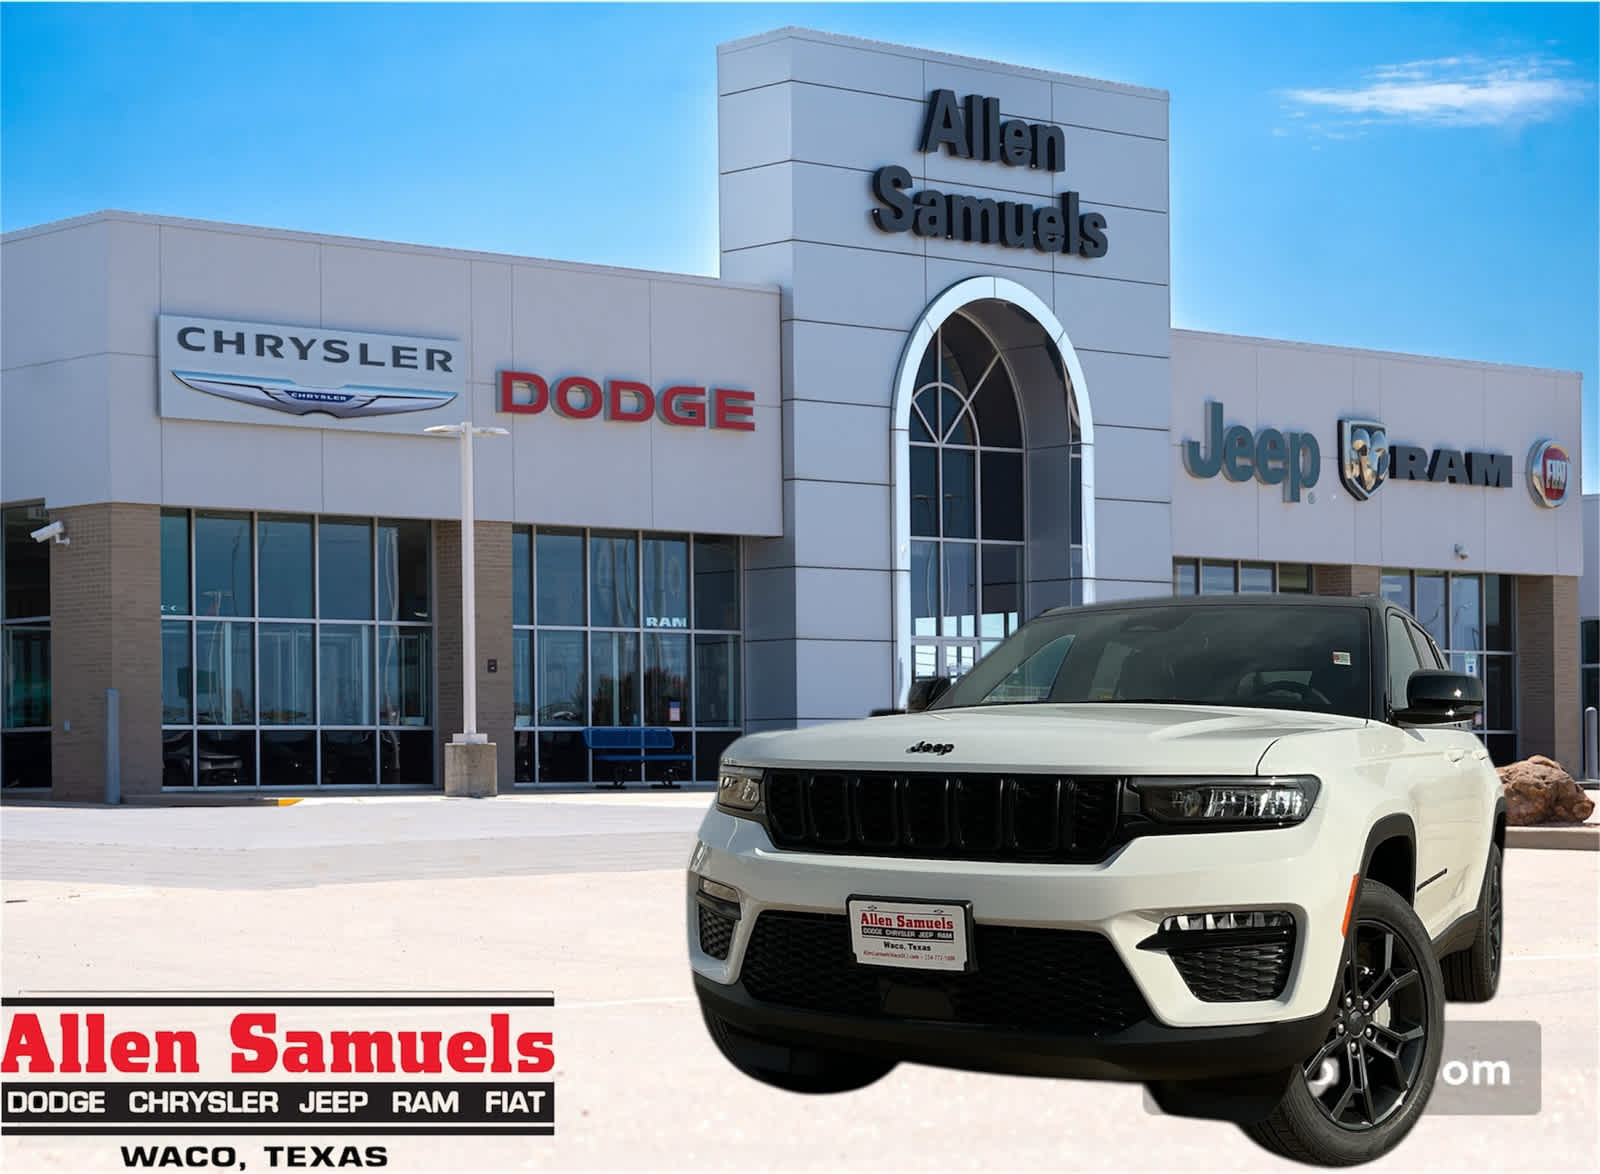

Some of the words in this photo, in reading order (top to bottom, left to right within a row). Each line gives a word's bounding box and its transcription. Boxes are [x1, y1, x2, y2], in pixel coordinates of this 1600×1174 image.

[918, 88, 1066, 172] Allen
[872, 165, 1108, 258] Samuels
[177, 326, 453, 373] CHRYSLER
[291, 392, 347, 401] CHRYSLER
[496, 370, 756, 432] DODGE
[1183, 400, 1321, 503] Jeep
[1390, 445, 1512, 488] RAM
[646, 616, 687, 627] RAM
[905, 740, 955, 756] Jeep
[861, 912, 892, 926] Allen
[896, 915, 954, 929] Samuels
[863, 927, 883, 935] DODGE
[883, 941, 906, 950] Waco,
[907, 943, 931, 951] Texas
